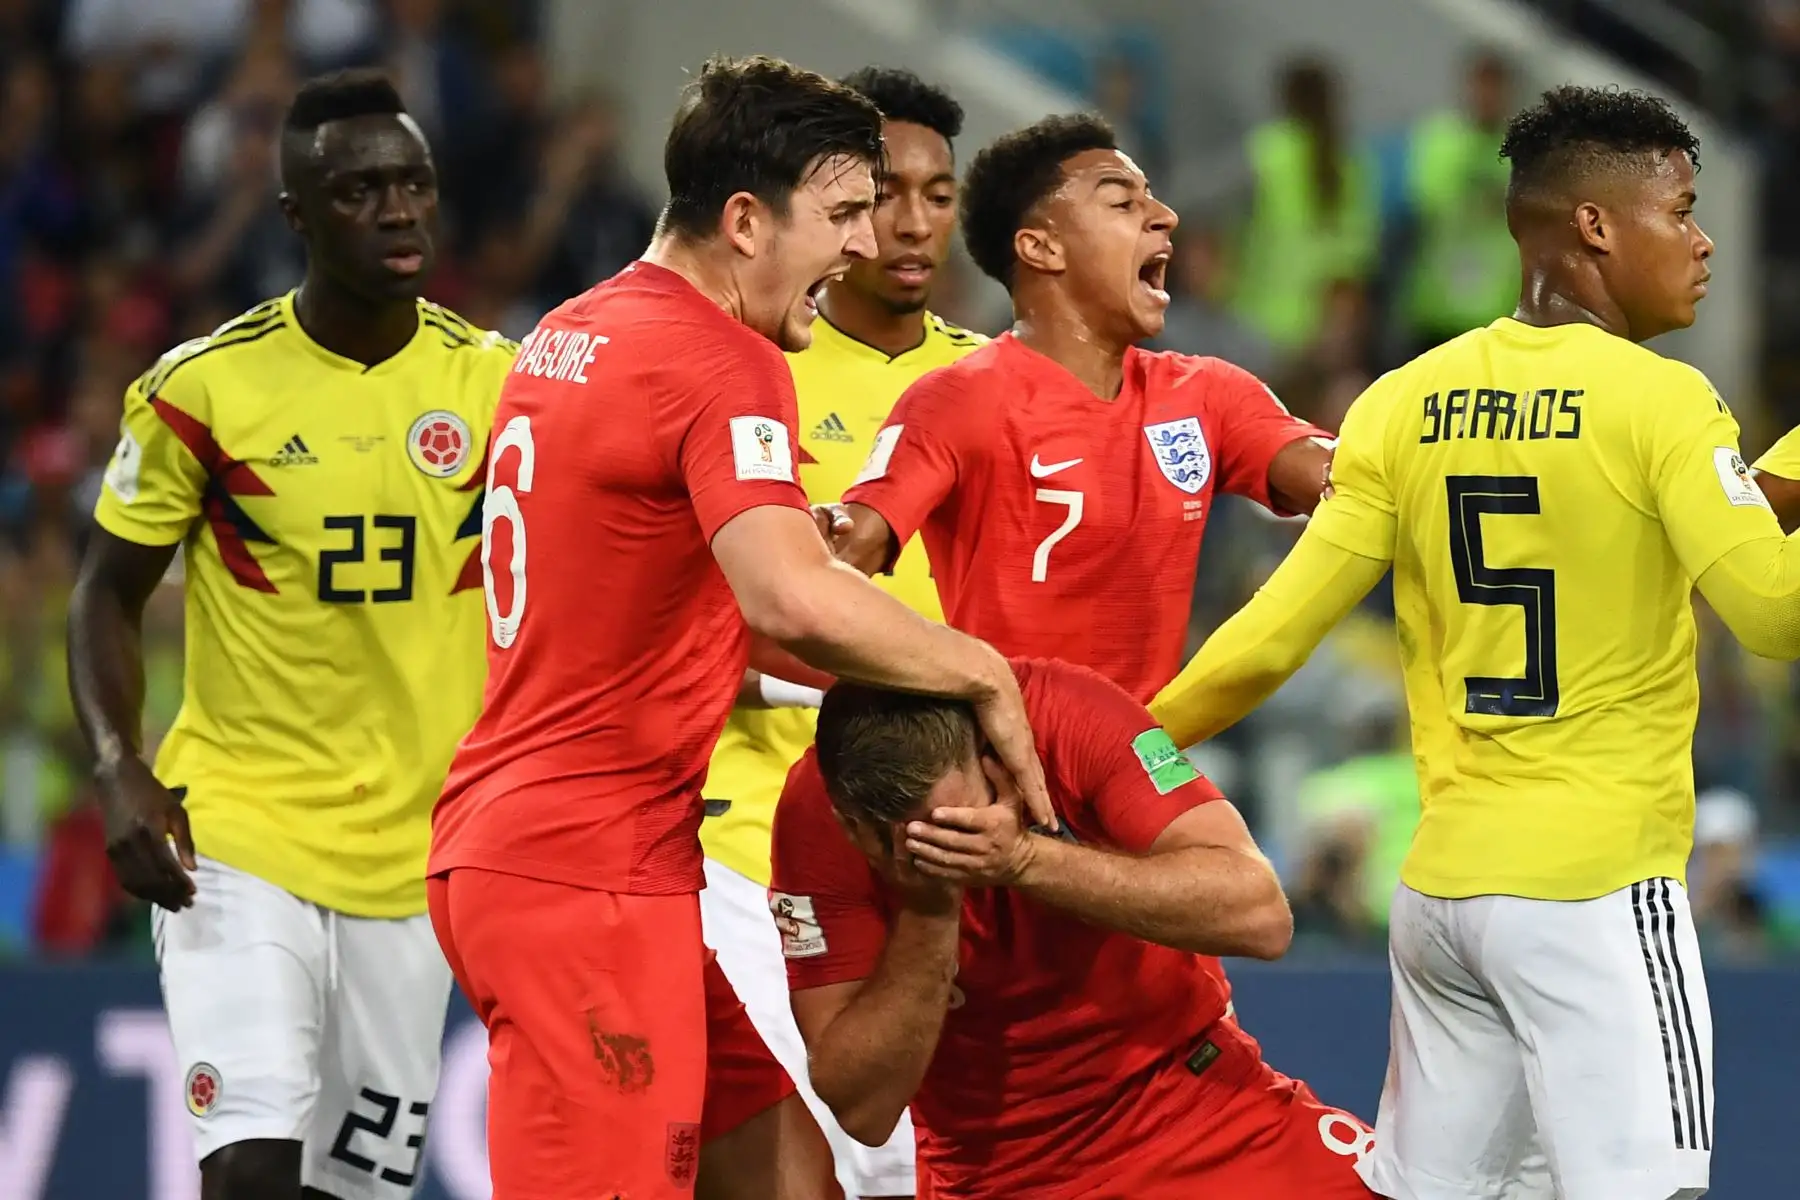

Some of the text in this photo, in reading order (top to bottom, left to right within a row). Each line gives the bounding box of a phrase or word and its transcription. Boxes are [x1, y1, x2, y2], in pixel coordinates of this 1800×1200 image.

[1419, 388, 1585, 444] BARRIOS
[318, 514, 416, 604] 23
[481, 415, 535, 649] 6
[1032, 488, 1084, 583] 7
[1445, 475, 1559, 717] 5
[329, 1086, 427, 1187] 23
